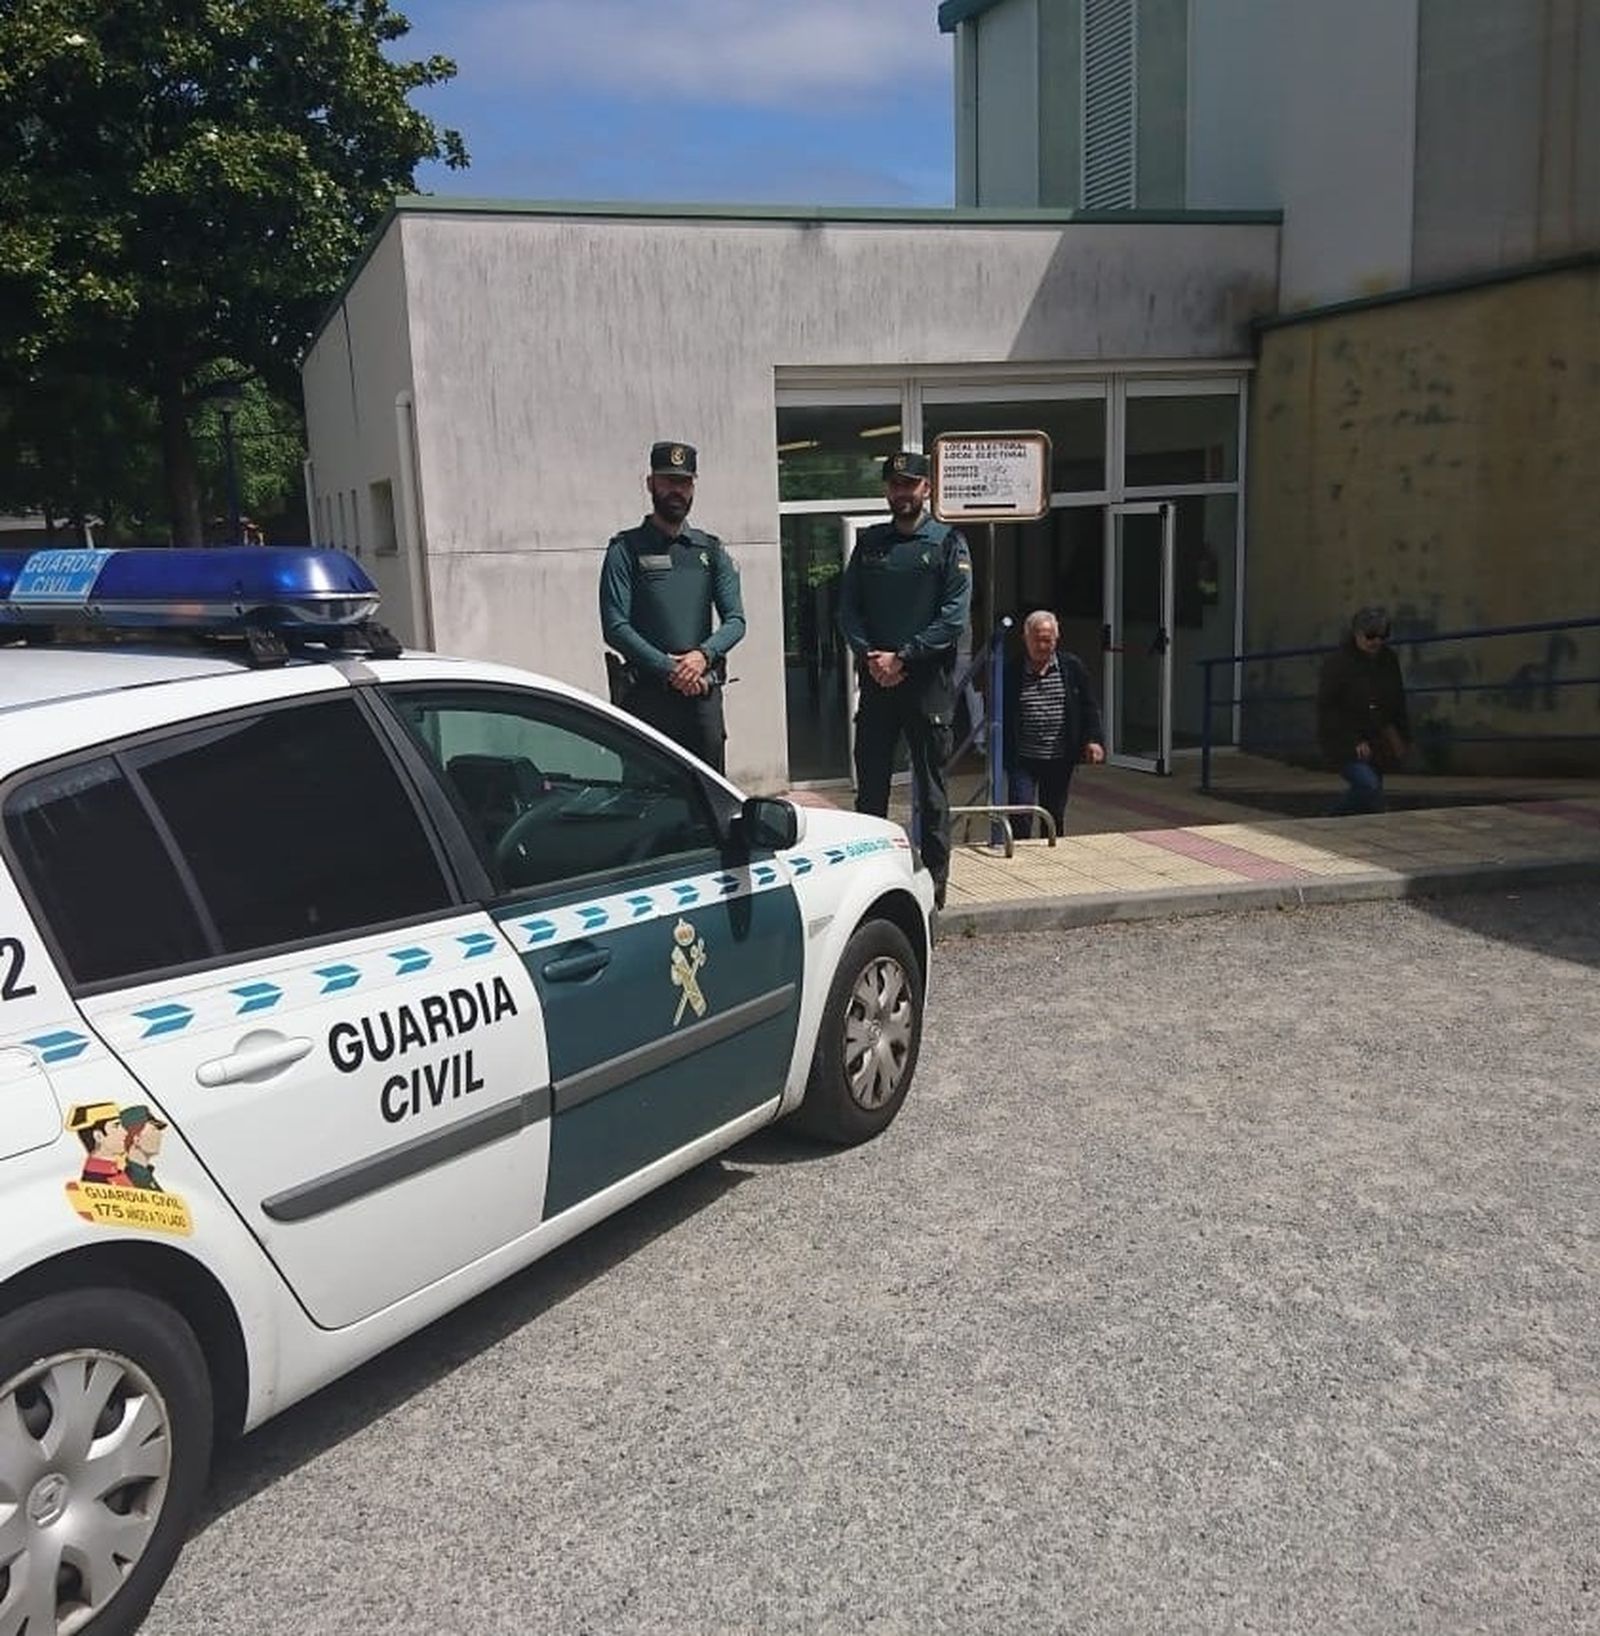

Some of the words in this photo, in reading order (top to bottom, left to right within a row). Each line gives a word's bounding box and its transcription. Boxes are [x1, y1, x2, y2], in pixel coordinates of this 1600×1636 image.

[944, 443, 972, 451] LOCAL
[25, 555, 101, 573] GUARDIA
[32, 576, 72, 593] CIVIL
[328, 976, 518, 1073] GUARDIA
[380, 1050, 484, 1123] CIVIL
[84, 1186, 150, 1204] GUARDIA
[151, 1194, 183, 1210] CIVIL
[94, 1203, 124, 1218] 175
